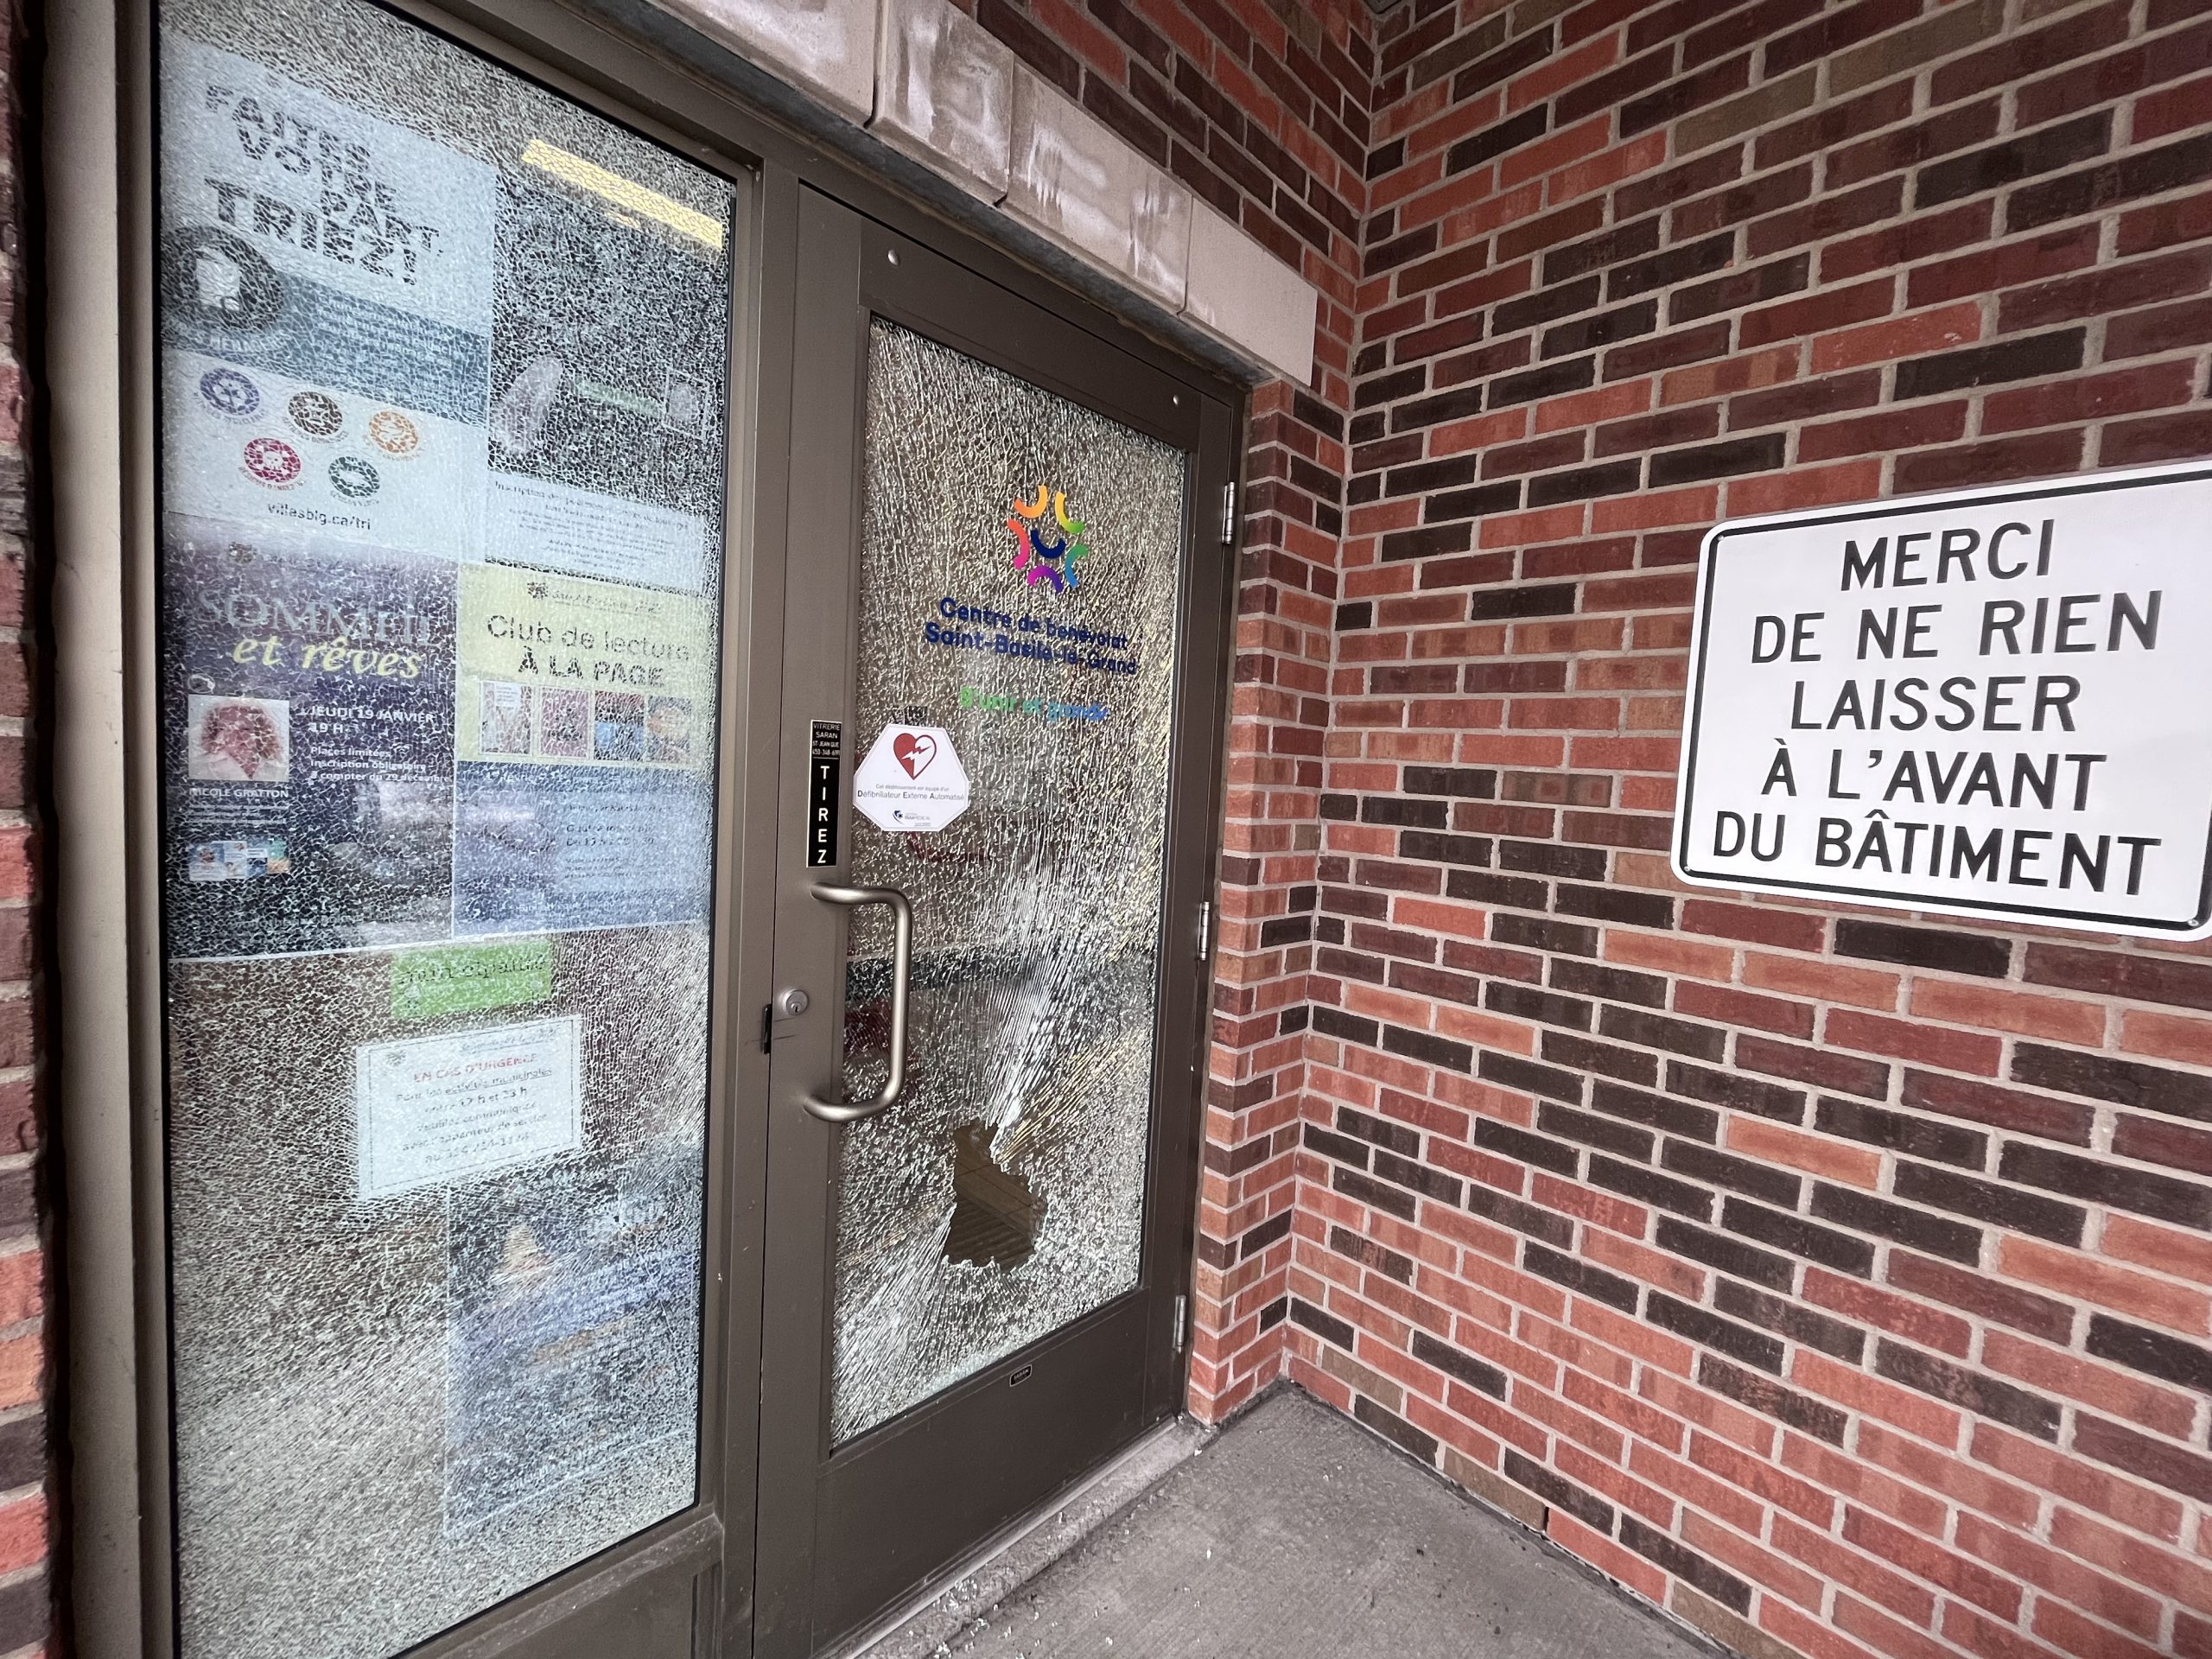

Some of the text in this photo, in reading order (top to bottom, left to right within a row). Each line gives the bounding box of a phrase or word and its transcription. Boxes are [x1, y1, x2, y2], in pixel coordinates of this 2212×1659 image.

[206, 85, 371, 172] FAITES
[237, 127, 397, 213] VOTRE
[204, 178, 417, 285] TRIEZ!
[1840, 518, 2055, 591] MERCI
[487, 614, 690, 662] Club de lecture
[940, 597, 1012, 628] Centre
[1018, 613, 1041, 633] de
[1751, 590, 2162, 664] DE NE RIEN
[232, 635, 423, 679] et rêves
[518, 645, 665, 690] À LA PAGE
[925, 622, 1138, 676] Saint-Basile-le-Grand
[308, 706, 435, 724] JEUDI 19 JANVIER
[813, 722, 841, 731] VITRERIE
[1790, 675, 2081, 732] LAISSER
[310, 747, 391, 759] Places limitées
[1761, 737, 2107, 811] À L'AVANT
[234, 789, 289, 798] GRATTON
[320, 773, 366, 784] compter
[903, 791, 927, 800] Externe
[817, 766, 830, 864] TIREZ
[1713, 809, 2162, 895] DU BÂTIMENT
[414, 1052, 538, 1084] EN CAS D'URGENCE
